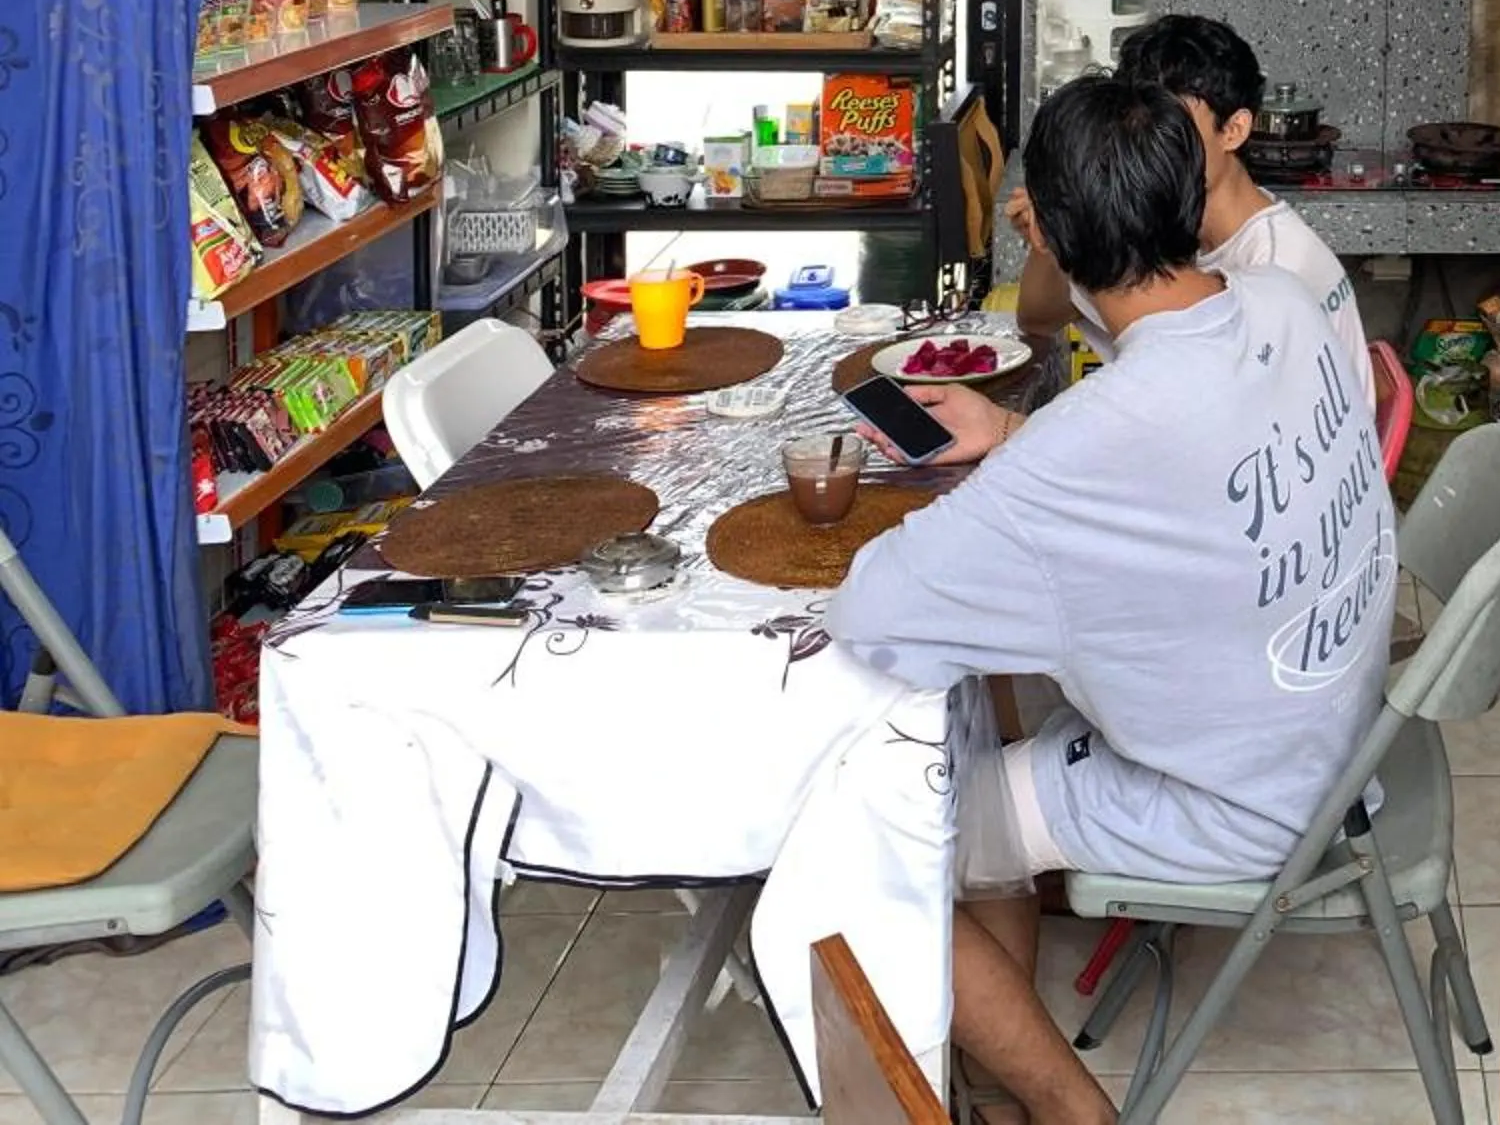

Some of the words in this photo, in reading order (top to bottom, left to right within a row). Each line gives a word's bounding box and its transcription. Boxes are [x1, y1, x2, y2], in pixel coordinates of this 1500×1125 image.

[840, 109, 896, 135] Puffs
[1227, 422, 1315, 542] It's
[1313, 341, 1351, 453] all
[1257, 539, 1312, 609] in
[1319, 427, 1378, 590] your
[1299, 510, 1383, 672] head
